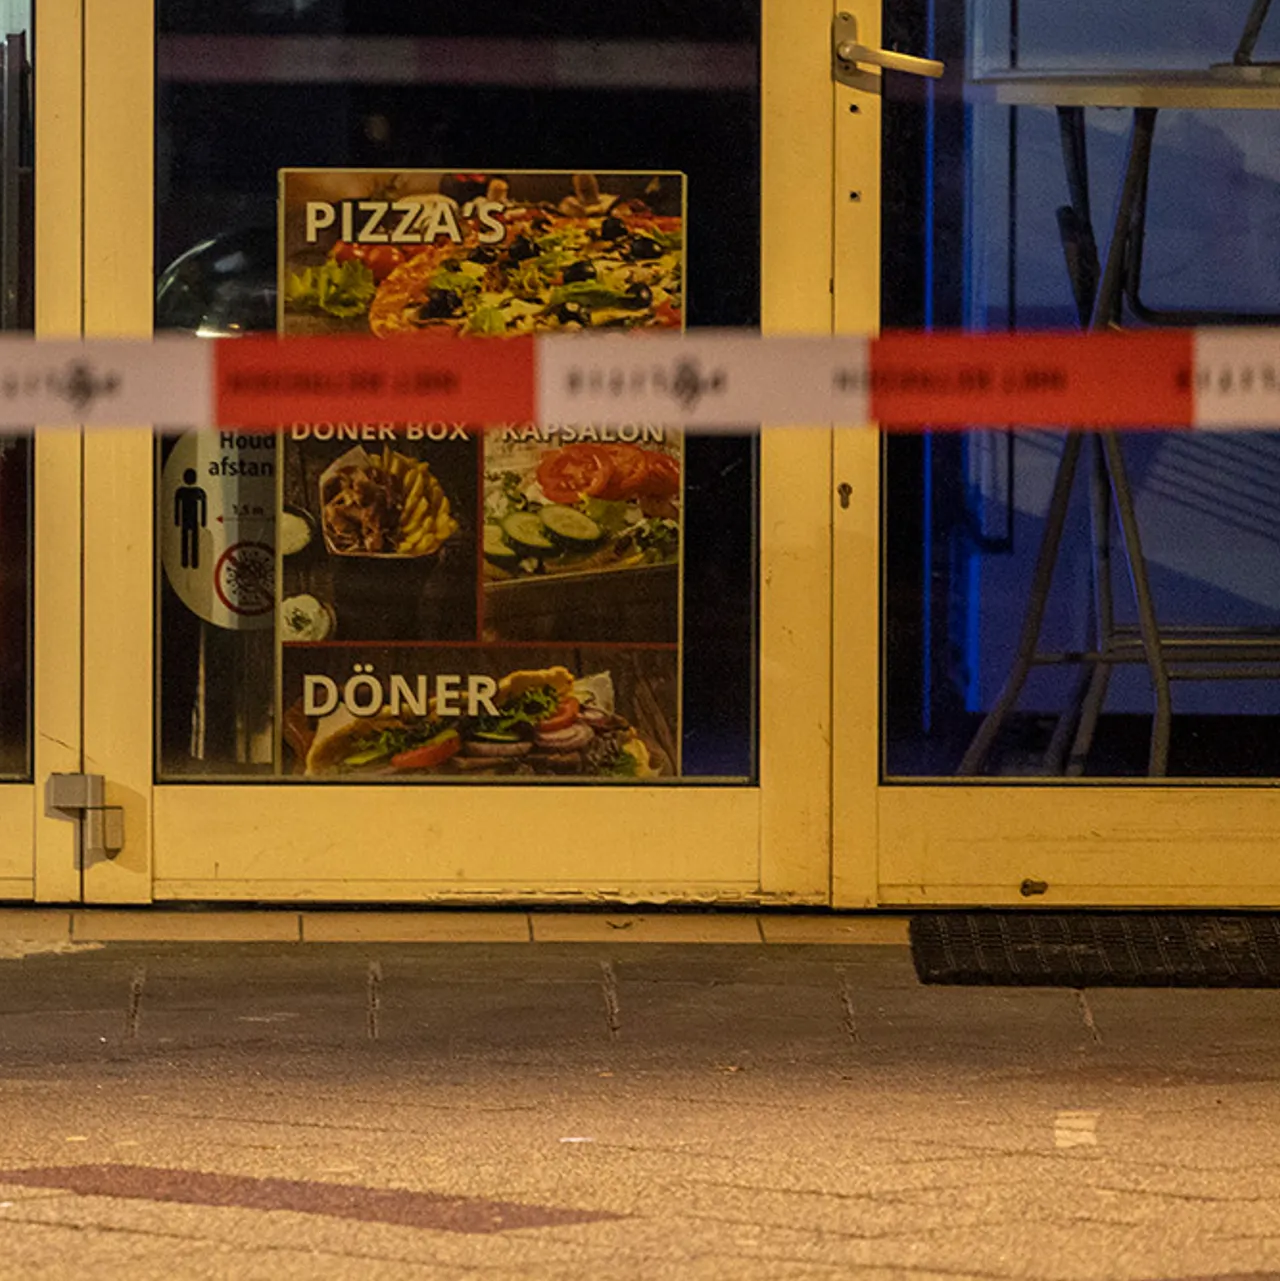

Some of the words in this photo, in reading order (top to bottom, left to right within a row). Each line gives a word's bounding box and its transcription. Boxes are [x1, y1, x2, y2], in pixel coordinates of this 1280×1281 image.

[305, 200, 508, 244] PIZZA'S
[220, 430, 276, 450] Houd
[405, 421, 471, 441] BOX
[501, 422, 666, 443] KAPSALON
[208, 456, 274, 477] afstan
[303, 663, 501, 717] DÖNER
